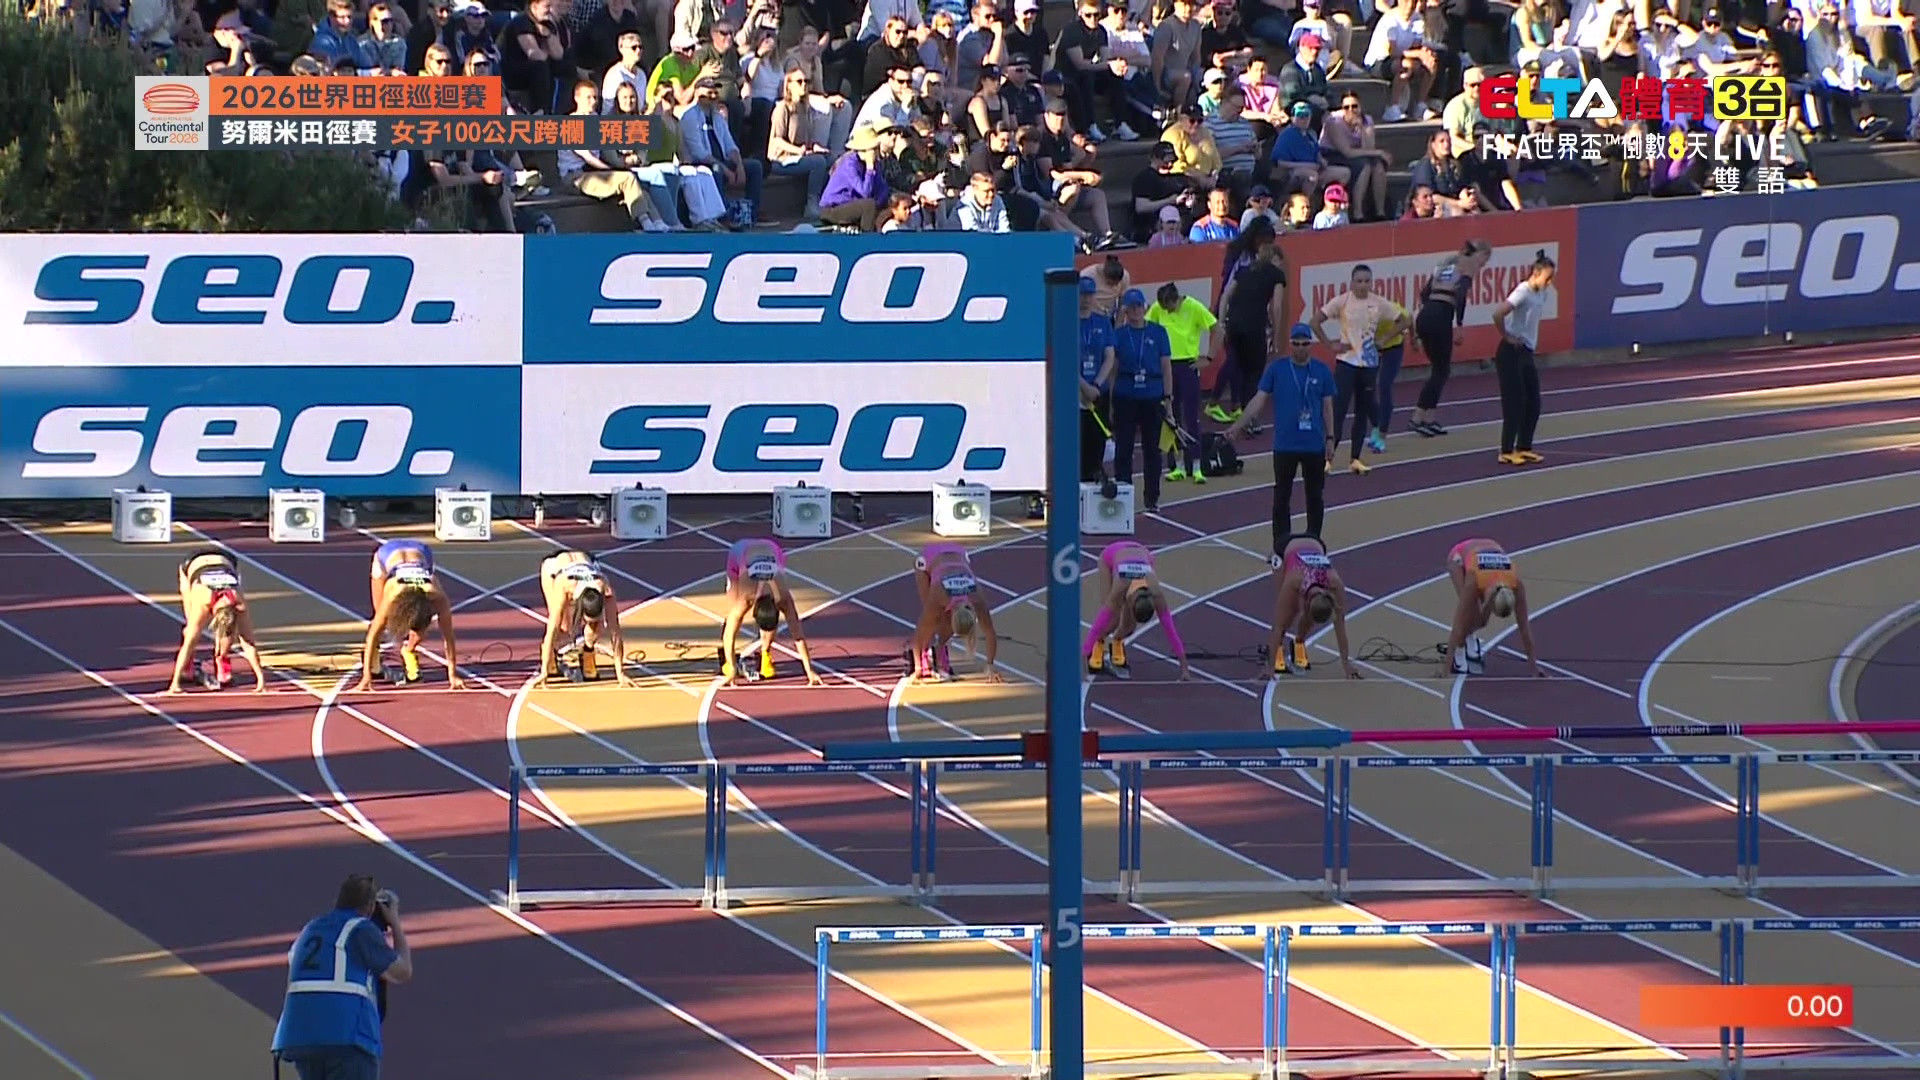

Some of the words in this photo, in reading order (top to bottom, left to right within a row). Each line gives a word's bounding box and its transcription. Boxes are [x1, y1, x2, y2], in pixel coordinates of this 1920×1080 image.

[1611, 214, 1920, 315] seo.
[24, 254, 456, 325] seo.
[589, 252, 1009, 324] seo.
[22, 404, 456, 478] seo.
[588, 403, 1007, 474] seo.
[159, 527, 167, 538] 7
[311, 526, 319, 538] 6
[479, 526, 487, 536] 5
[654, 525, 662, 536] 4
[819, 523, 827, 533] 3
[979, 521, 987, 532] 2
[1051, 542, 1080, 585] 6
[1056, 907, 1080, 948] 5
[303, 936, 322, 970] 2
